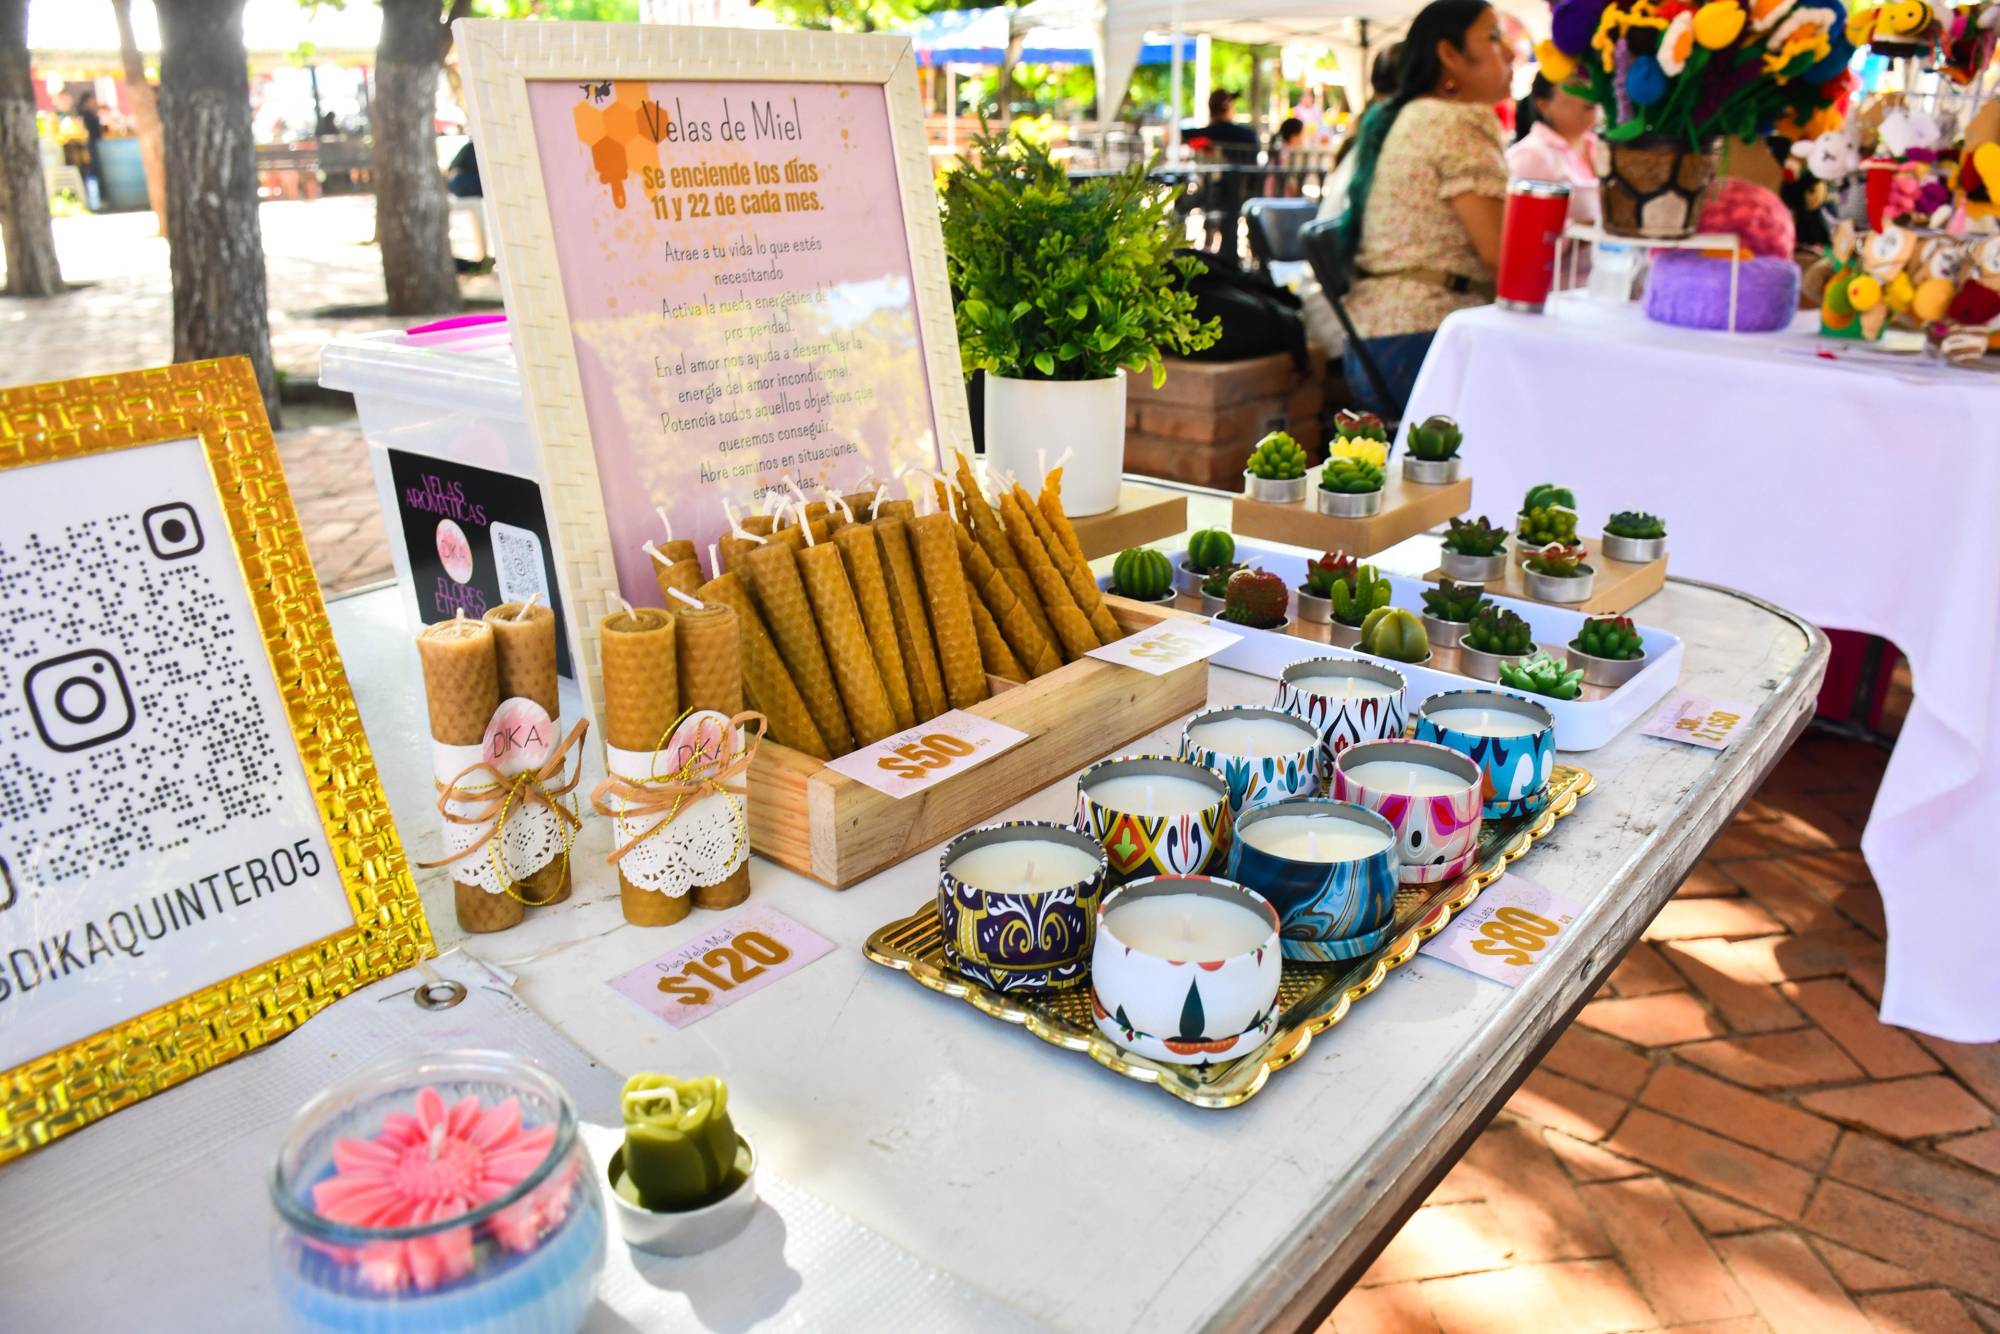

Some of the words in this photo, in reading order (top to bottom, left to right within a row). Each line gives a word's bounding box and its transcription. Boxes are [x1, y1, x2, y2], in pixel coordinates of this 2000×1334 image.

[641, 97, 713, 144] Velas
[720, 97, 747, 142] de
[751, 97, 803, 141] Miel
[642, 165, 665, 190] Se
[670, 162, 751, 189] enciende
[754, 161, 780, 186] los
[784, 158, 819, 184] días
[651, 196, 669, 220] 11
[672, 196, 682, 221] y
[687, 194, 711, 218] 22
[715, 193, 737, 217] de
[741, 190, 781, 215] cada
[784, 190, 825, 213] mes.
[665, 241, 700, 263] Atrae
[702, 248, 710, 259] a
[712, 245, 726, 259] tu
[728, 234, 753, 257] vida
[754, 234, 767, 255] lo
[769, 242, 790, 259] que
[792, 236, 823, 253] estés
[714, 259, 784, 286] necesitando
[662, 298, 701, 320] Activa
[703, 293, 716, 315] la
[719, 290, 752, 312] rueda
[654, 356, 672, 378] En
[675, 353, 686, 376] el
[690, 359, 720, 374] amor
[723, 354, 745, 369] nos
[747, 340, 781, 370] ayuda
[783, 349, 790, 361] a
[678, 382, 723, 404] energía
[725, 372, 743, 396] del
[747, 376, 775, 392] amor
[660, 411, 716, 434] Potencia
[719, 400, 752, 424] todos
[754, 392, 801, 421] aquellos
[804, 384, 852, 413] objetivos
[719, 430, 775, 457] queremos
[777, 420, 834, 441] conseguir.
[700, 460, 730, 484] Abre
[732, 454, 779, 477] caminos
[782, 454, 796, 469] en
[798, 440, 859, 465] situaciones
[421, 473, 465, 503] VELAS
[753, 469, 819, 500] estancdas.
[877, 734, 977, 780] $50
[1470, 906, 1560, 966] $80
[656, 931, 793, 1005] $120
